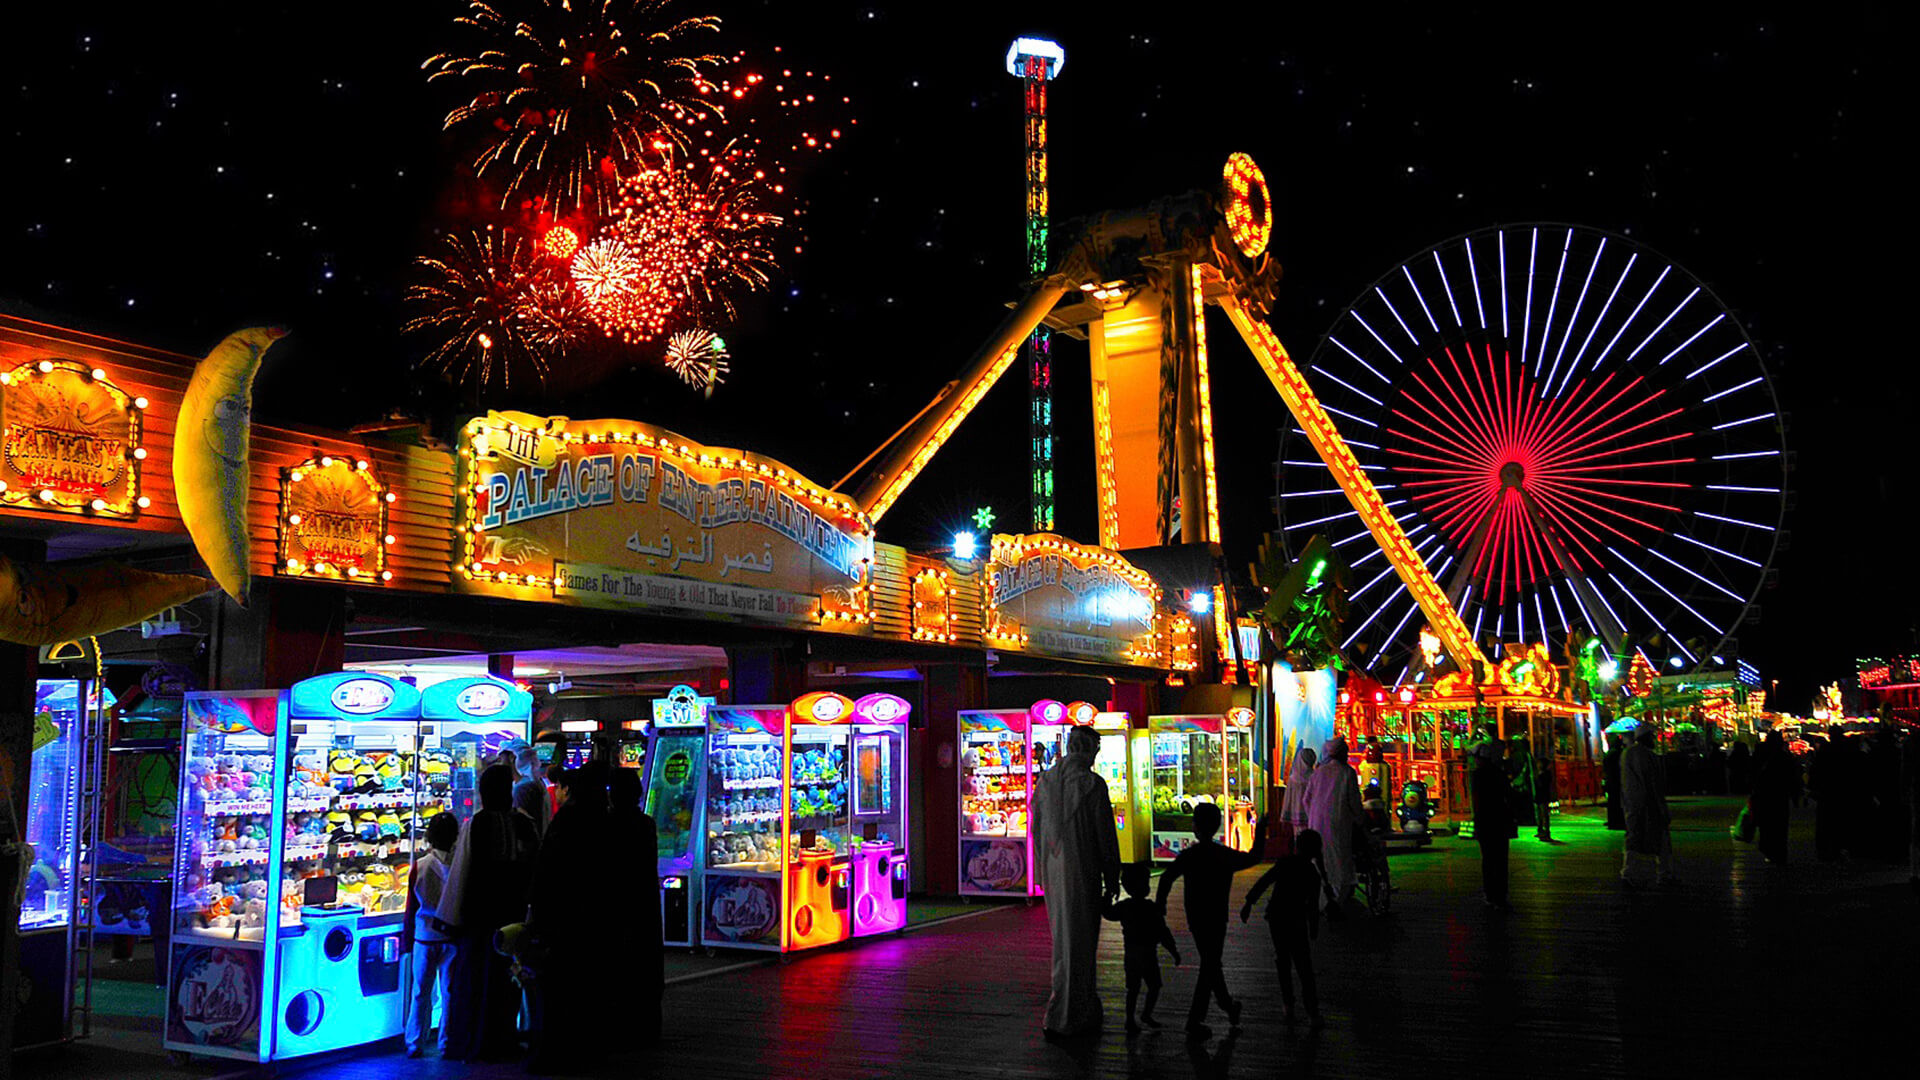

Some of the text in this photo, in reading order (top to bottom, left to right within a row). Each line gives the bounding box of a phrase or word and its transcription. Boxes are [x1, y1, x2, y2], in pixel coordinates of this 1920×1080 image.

[9, 424, 120, 471] FANTASY
[505, 430, 541, 462] THE
[482, 452, 861, 583] PALACE OF ENTERTAINMENT
[625, 525, 774, 577] قصر الترفيه
[559, 568, 598, 592] Games
[601, 573, 620, 594] For
[622, 576, 643, 596] The
[647, 580, 677, 604] Young
[679, 585, 686, 601] &
[689, 584, 705, 605] Old
[708, 588, 728, 607] That
[731, 591, 756, 611] Never
[759, 594, 774, 612] Fail
[993, 554, 1042, 606] PALACE
